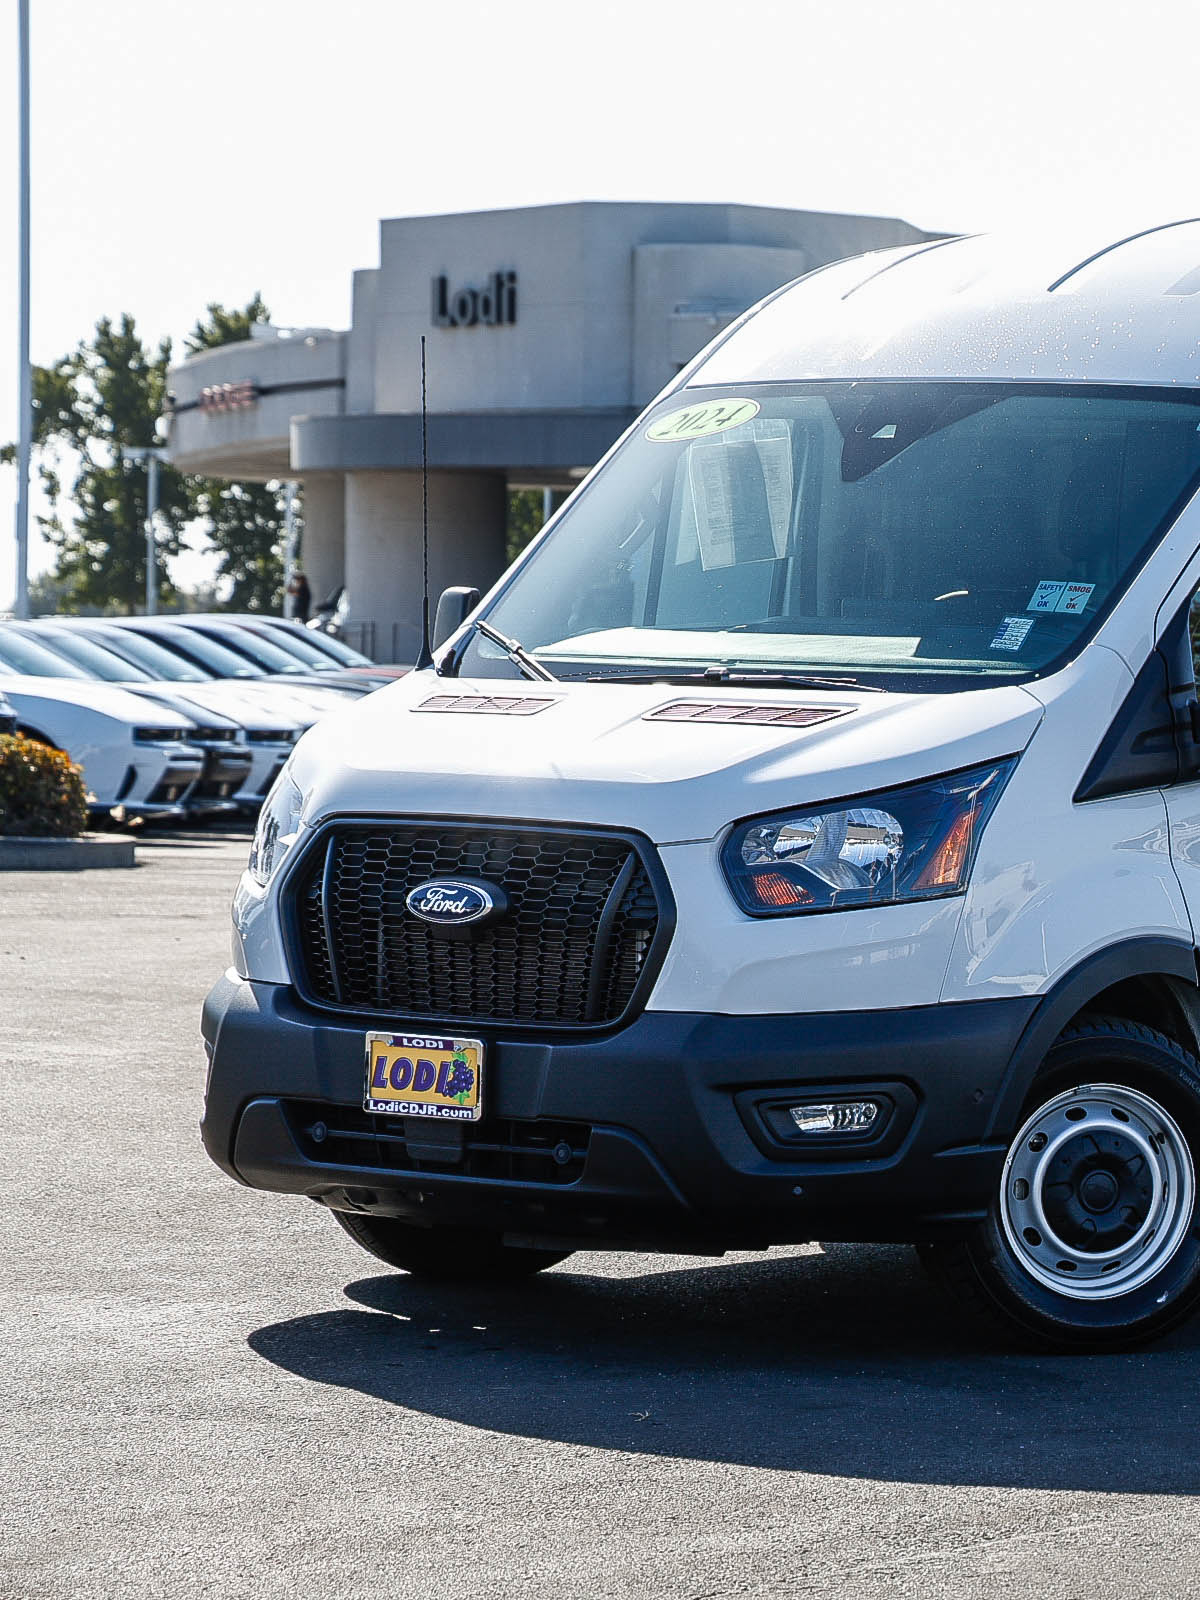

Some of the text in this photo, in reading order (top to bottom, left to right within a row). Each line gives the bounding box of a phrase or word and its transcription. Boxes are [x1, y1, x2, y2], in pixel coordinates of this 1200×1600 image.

[431, 270, 517, 328] Lodi
[656, 404, 749, 437] 2024
[1037, 583, 1063, 591] SAFETY
[1067, 585, 1092, 593] SMOG
[1065, 602, 1077, 610] OK
[420, 887, 469, 913] Ford
[402, 1038, 444, 1049] LODI
[371, 1056, 452, 1093] LODI
[369, 1099, 472, 1118] LodiCDJR.com
